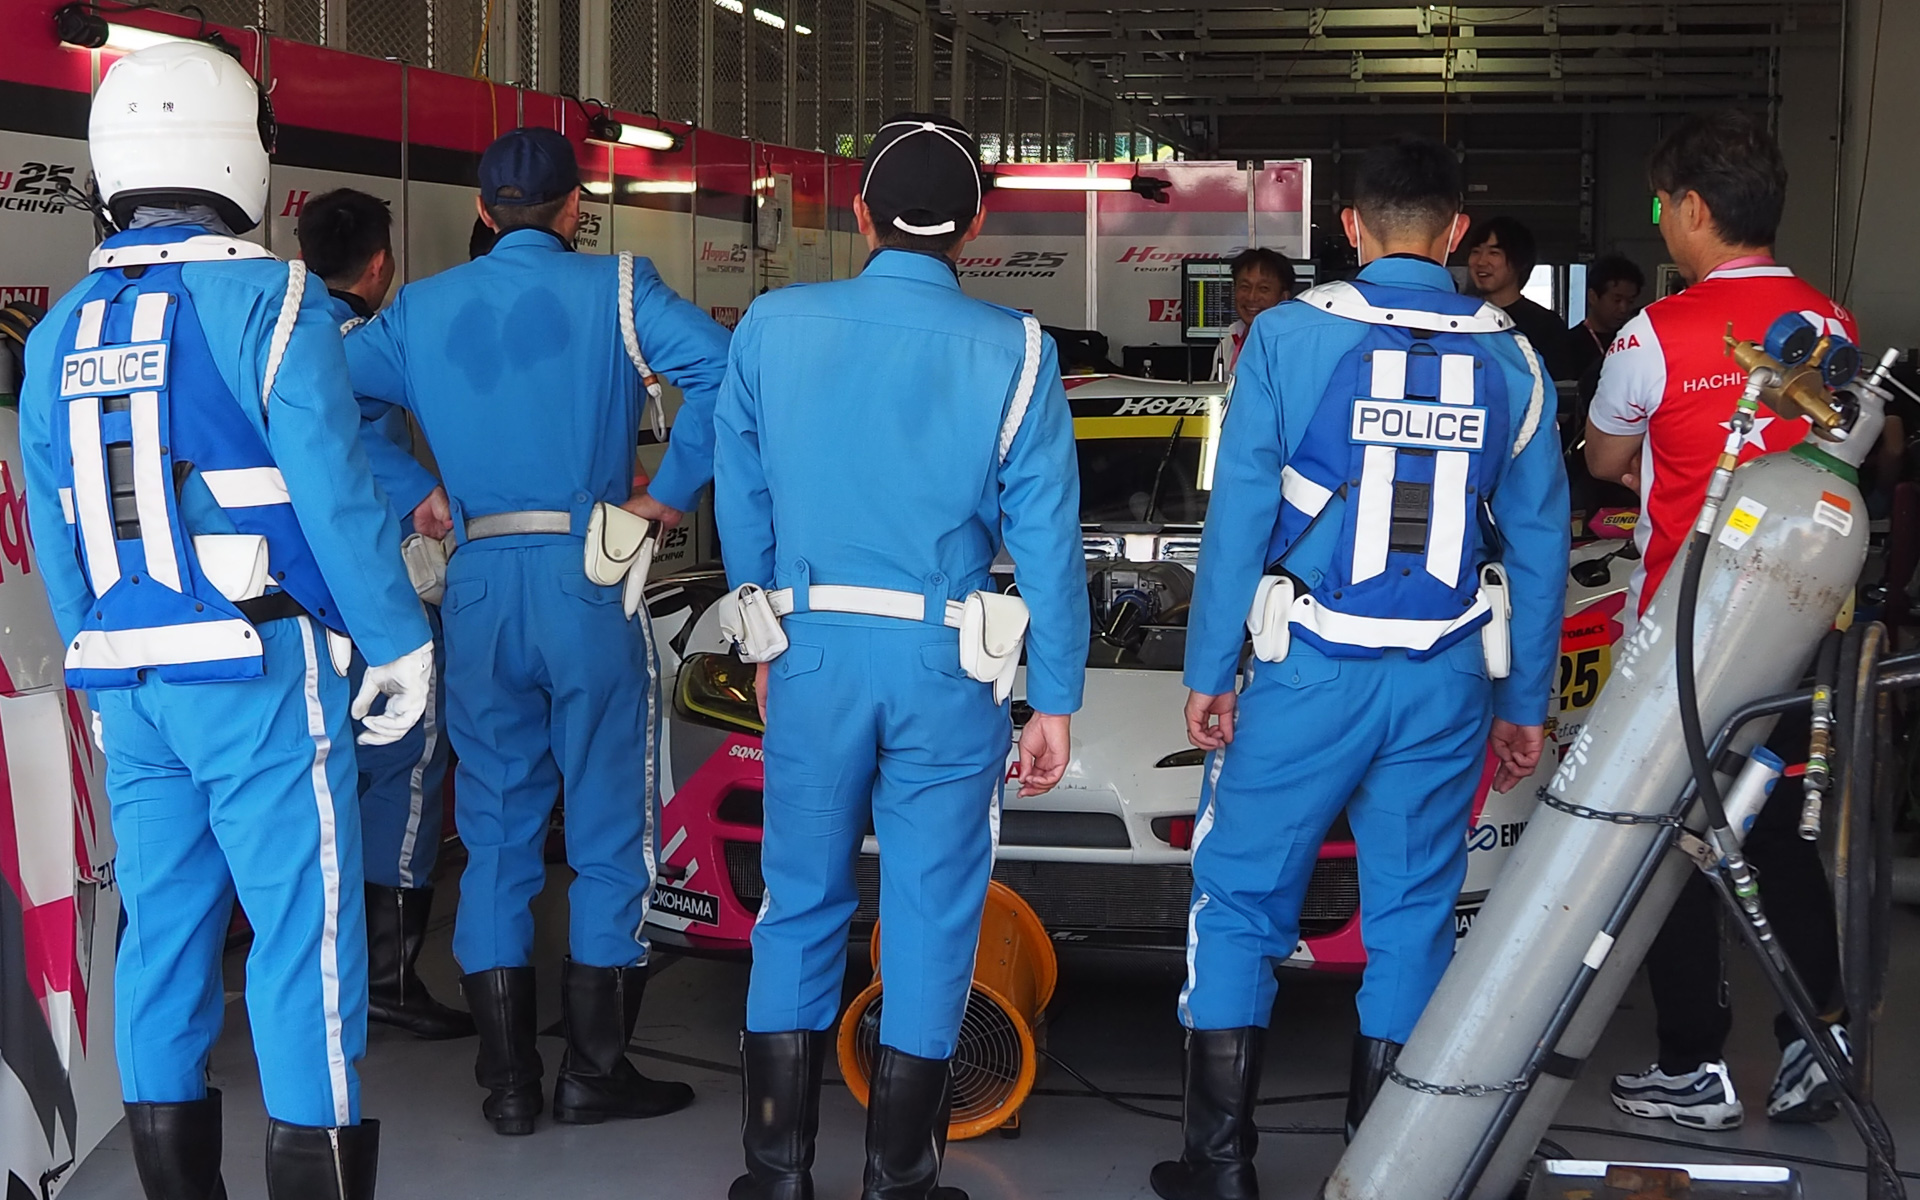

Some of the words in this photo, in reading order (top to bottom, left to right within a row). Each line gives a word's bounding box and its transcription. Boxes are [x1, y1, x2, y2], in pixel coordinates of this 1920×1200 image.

[14, 162, 75, 195] 25
[731, 244, 748, 262] 25
[1005, 252, 1068, 268] 25
[64, 351, 159, 390] POLICE
[1683, 372, 1749, 393] HACHI-
[1359, 407, 1480, 443] POLICE
[664, 527, 689, 549] 25
